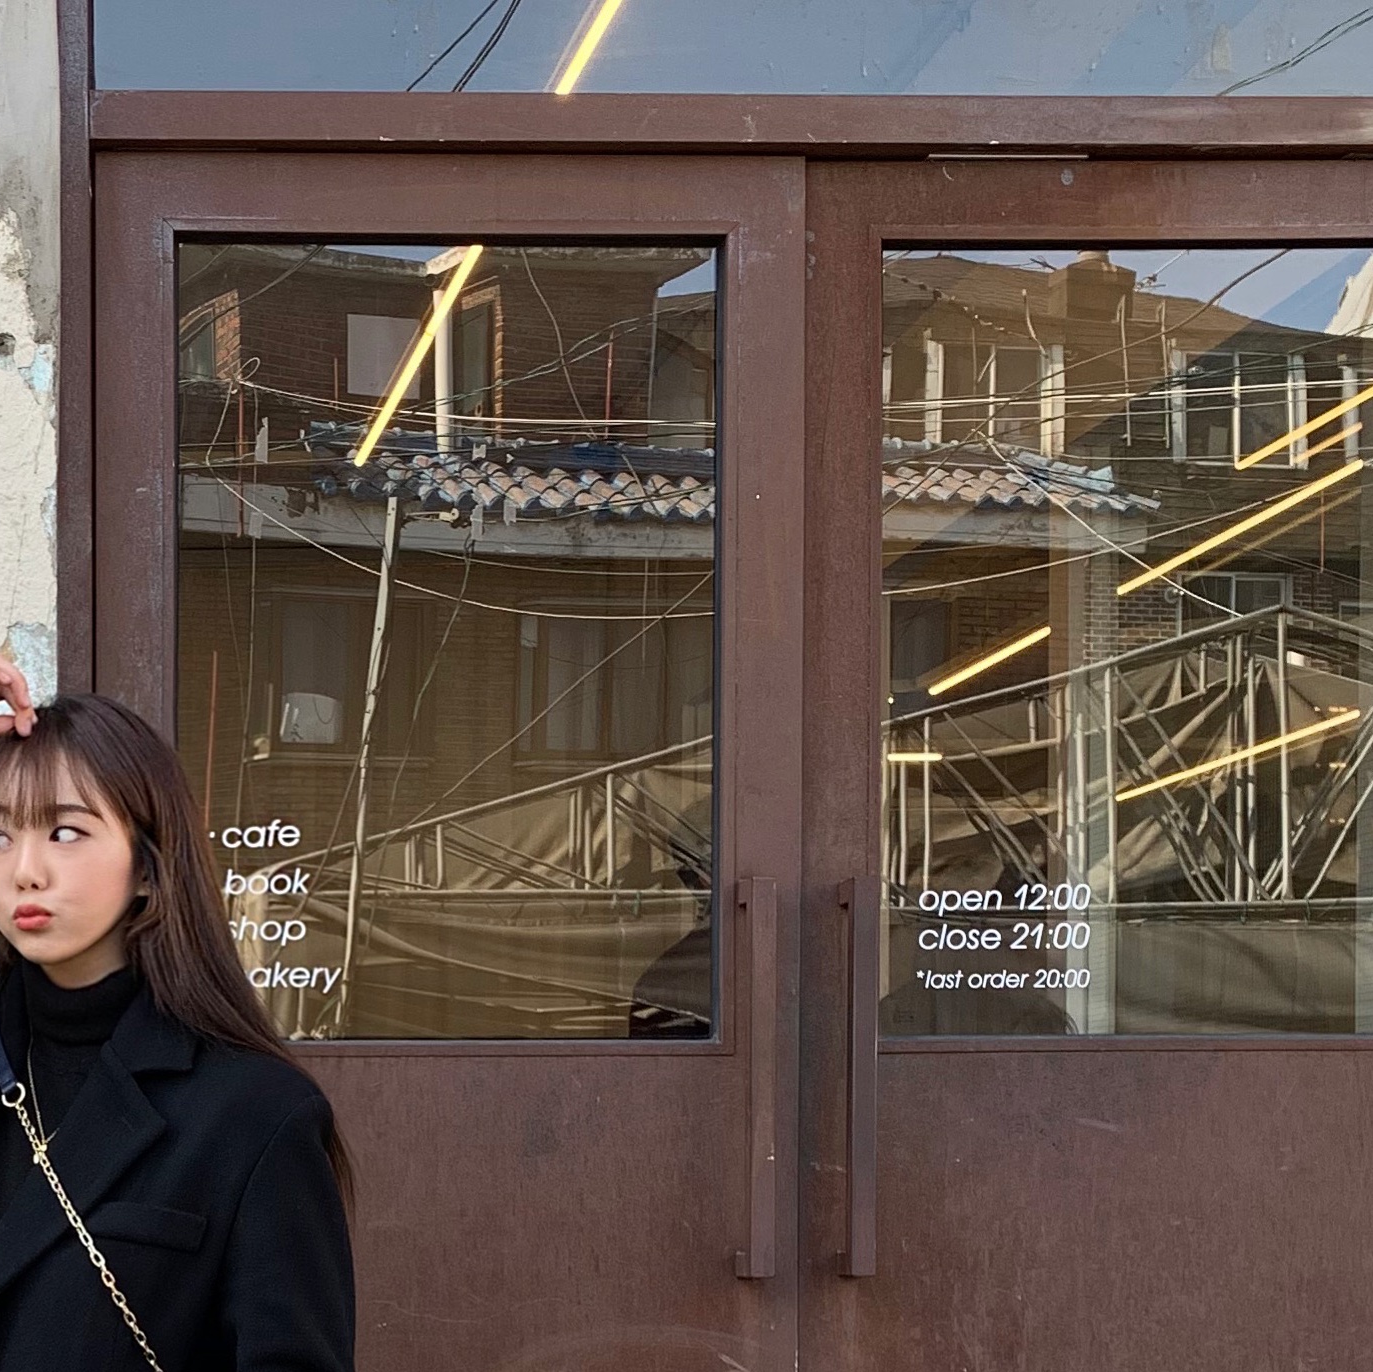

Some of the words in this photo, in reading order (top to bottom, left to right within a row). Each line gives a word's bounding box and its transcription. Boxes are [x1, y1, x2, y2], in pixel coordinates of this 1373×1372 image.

[222, 819, 301, 848] cafe
[224, 868, 310, 895] book
[918, 889, 1002, 917] open
[1014, 883, 1092, 911] 12:00
[918, 924, 1002, 950] close
[1010, 922, 1091, 950] 21:00
[245, 961, 342, 994] akery
[968, 970, 1029, 989] order
[1033, 969, 1091, 989] 20:00
